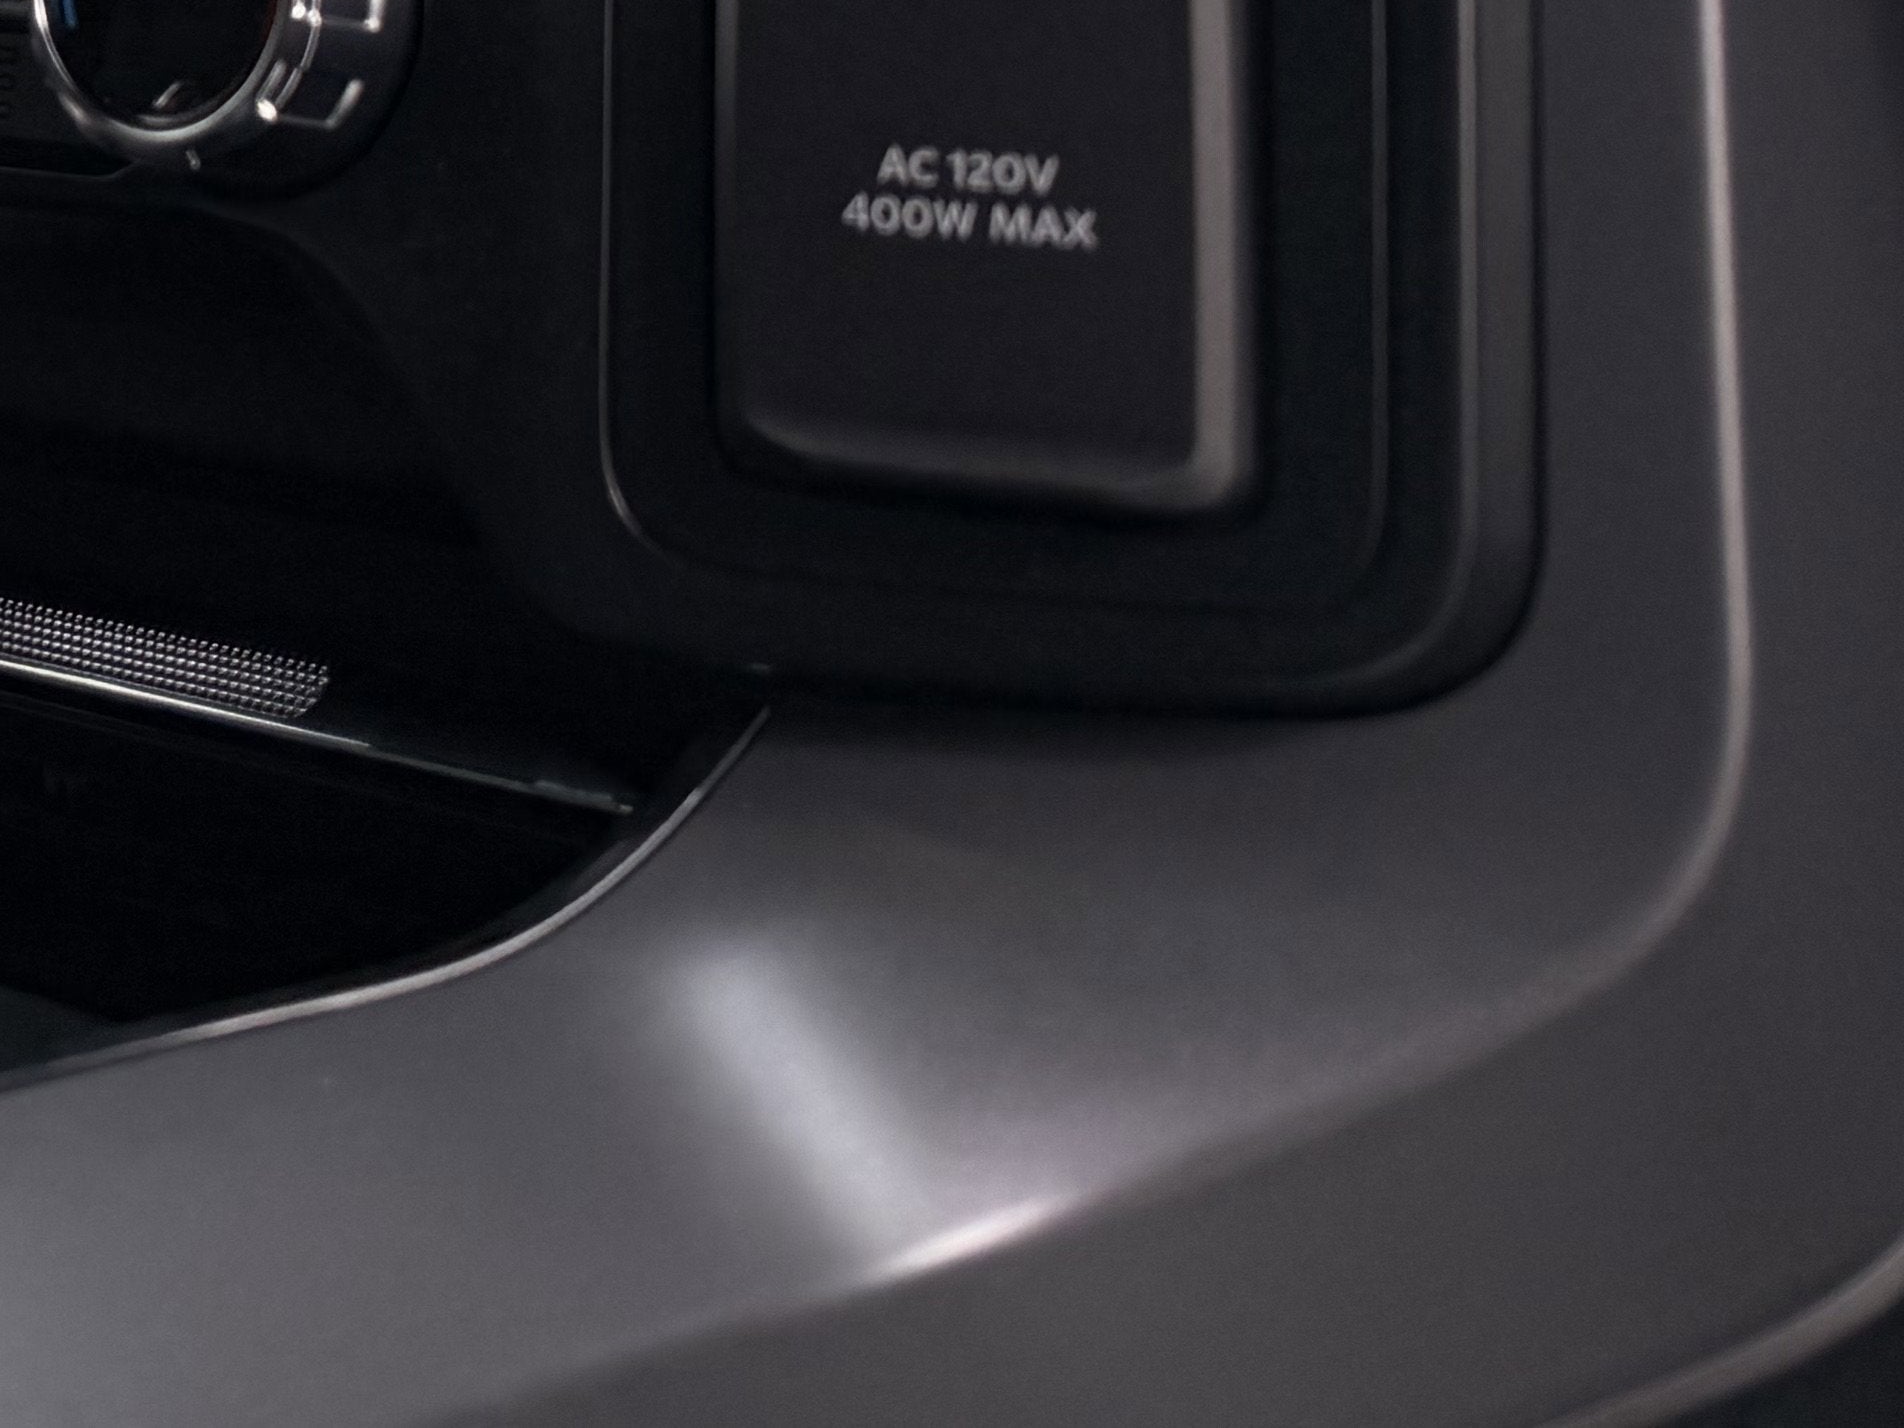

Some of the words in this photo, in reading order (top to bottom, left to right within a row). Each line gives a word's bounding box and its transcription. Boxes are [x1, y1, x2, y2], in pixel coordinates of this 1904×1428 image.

[876, 142, 940, 189] AC
[945, 148, 1061, 196] 120V
[842, 191, 979, 240] 400W
[989, 201, 1098, 251] MAX
